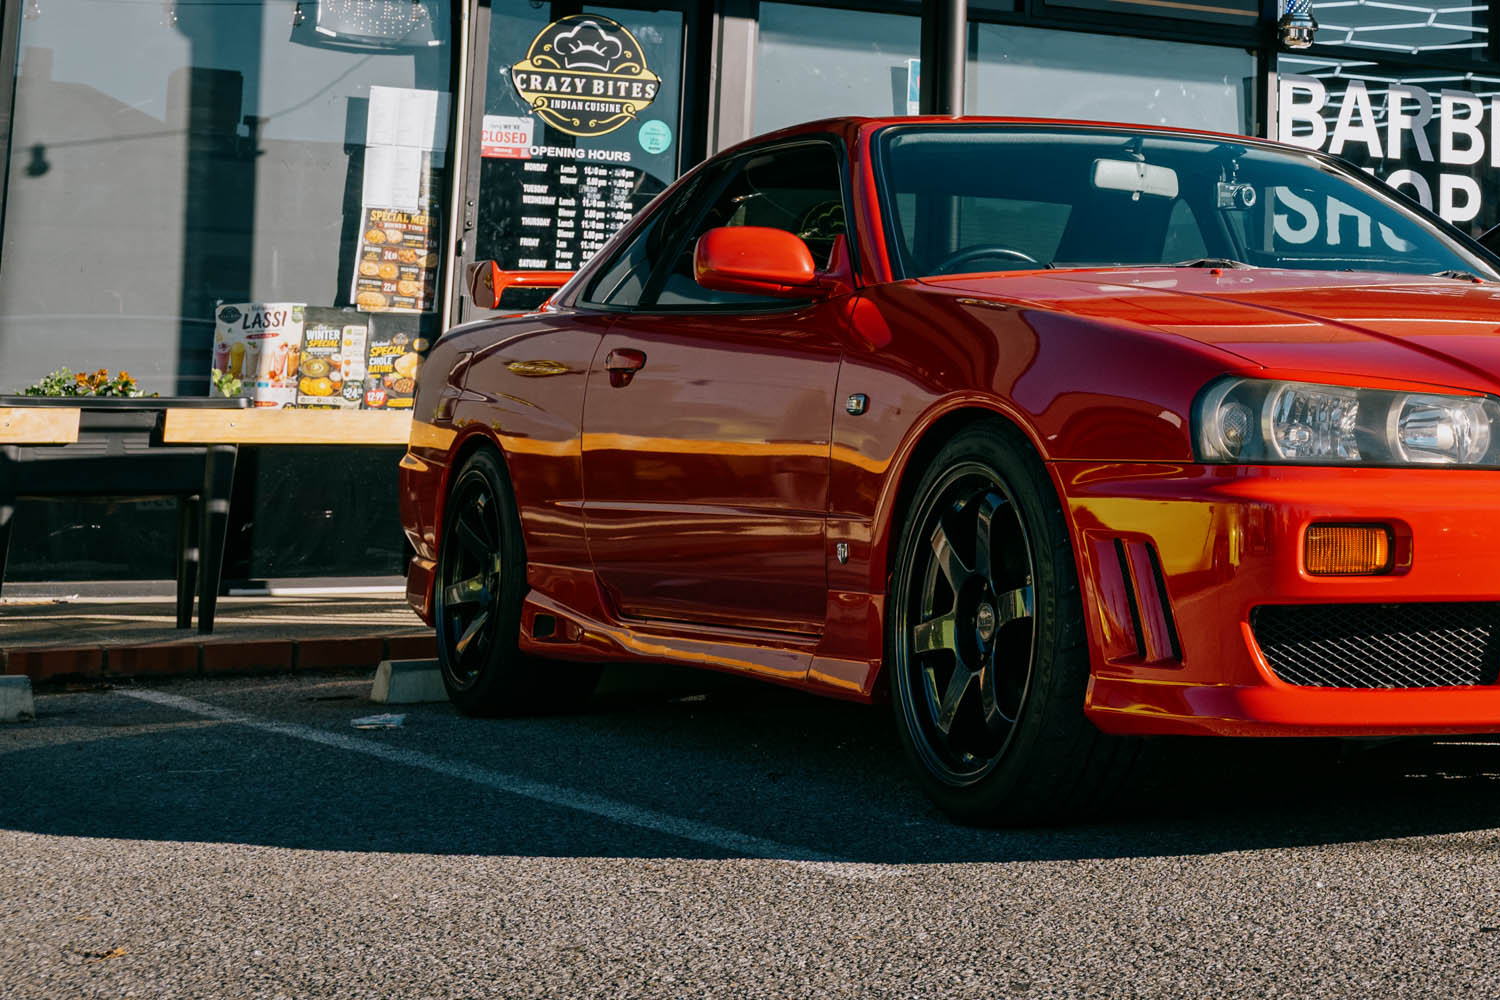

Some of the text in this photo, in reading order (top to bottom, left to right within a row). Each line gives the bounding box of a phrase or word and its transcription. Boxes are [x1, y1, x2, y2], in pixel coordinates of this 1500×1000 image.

[516, 73, 656, 99] CRAZY BITES
[550, 99, 621, 113] INDIAN CUISINE
[481, 130, 527, 144] CLOSED
[529, 146, 585, 159] OPENING
[588, 149, 631, 162] HOURS
[524, 162, 548, 172] MONDAY
[523, 184, 549, 193] TUESDAY
[523, 195, 556, 205] WEDNESDAY
[370, 209, 409, 222] SPECIAL
[521, 217, 551, 226] THURSDAY
[520, 237, 540, 247] FRIDAY
[518, 258, 547, 268] SATURDAY
[242, 311, 288, 330] LASSI
[306, 329, 340, 340] WINTER
[308, 339, 340, 348] SPECIAL
[369, 345, 407, 358] SPECIAL
